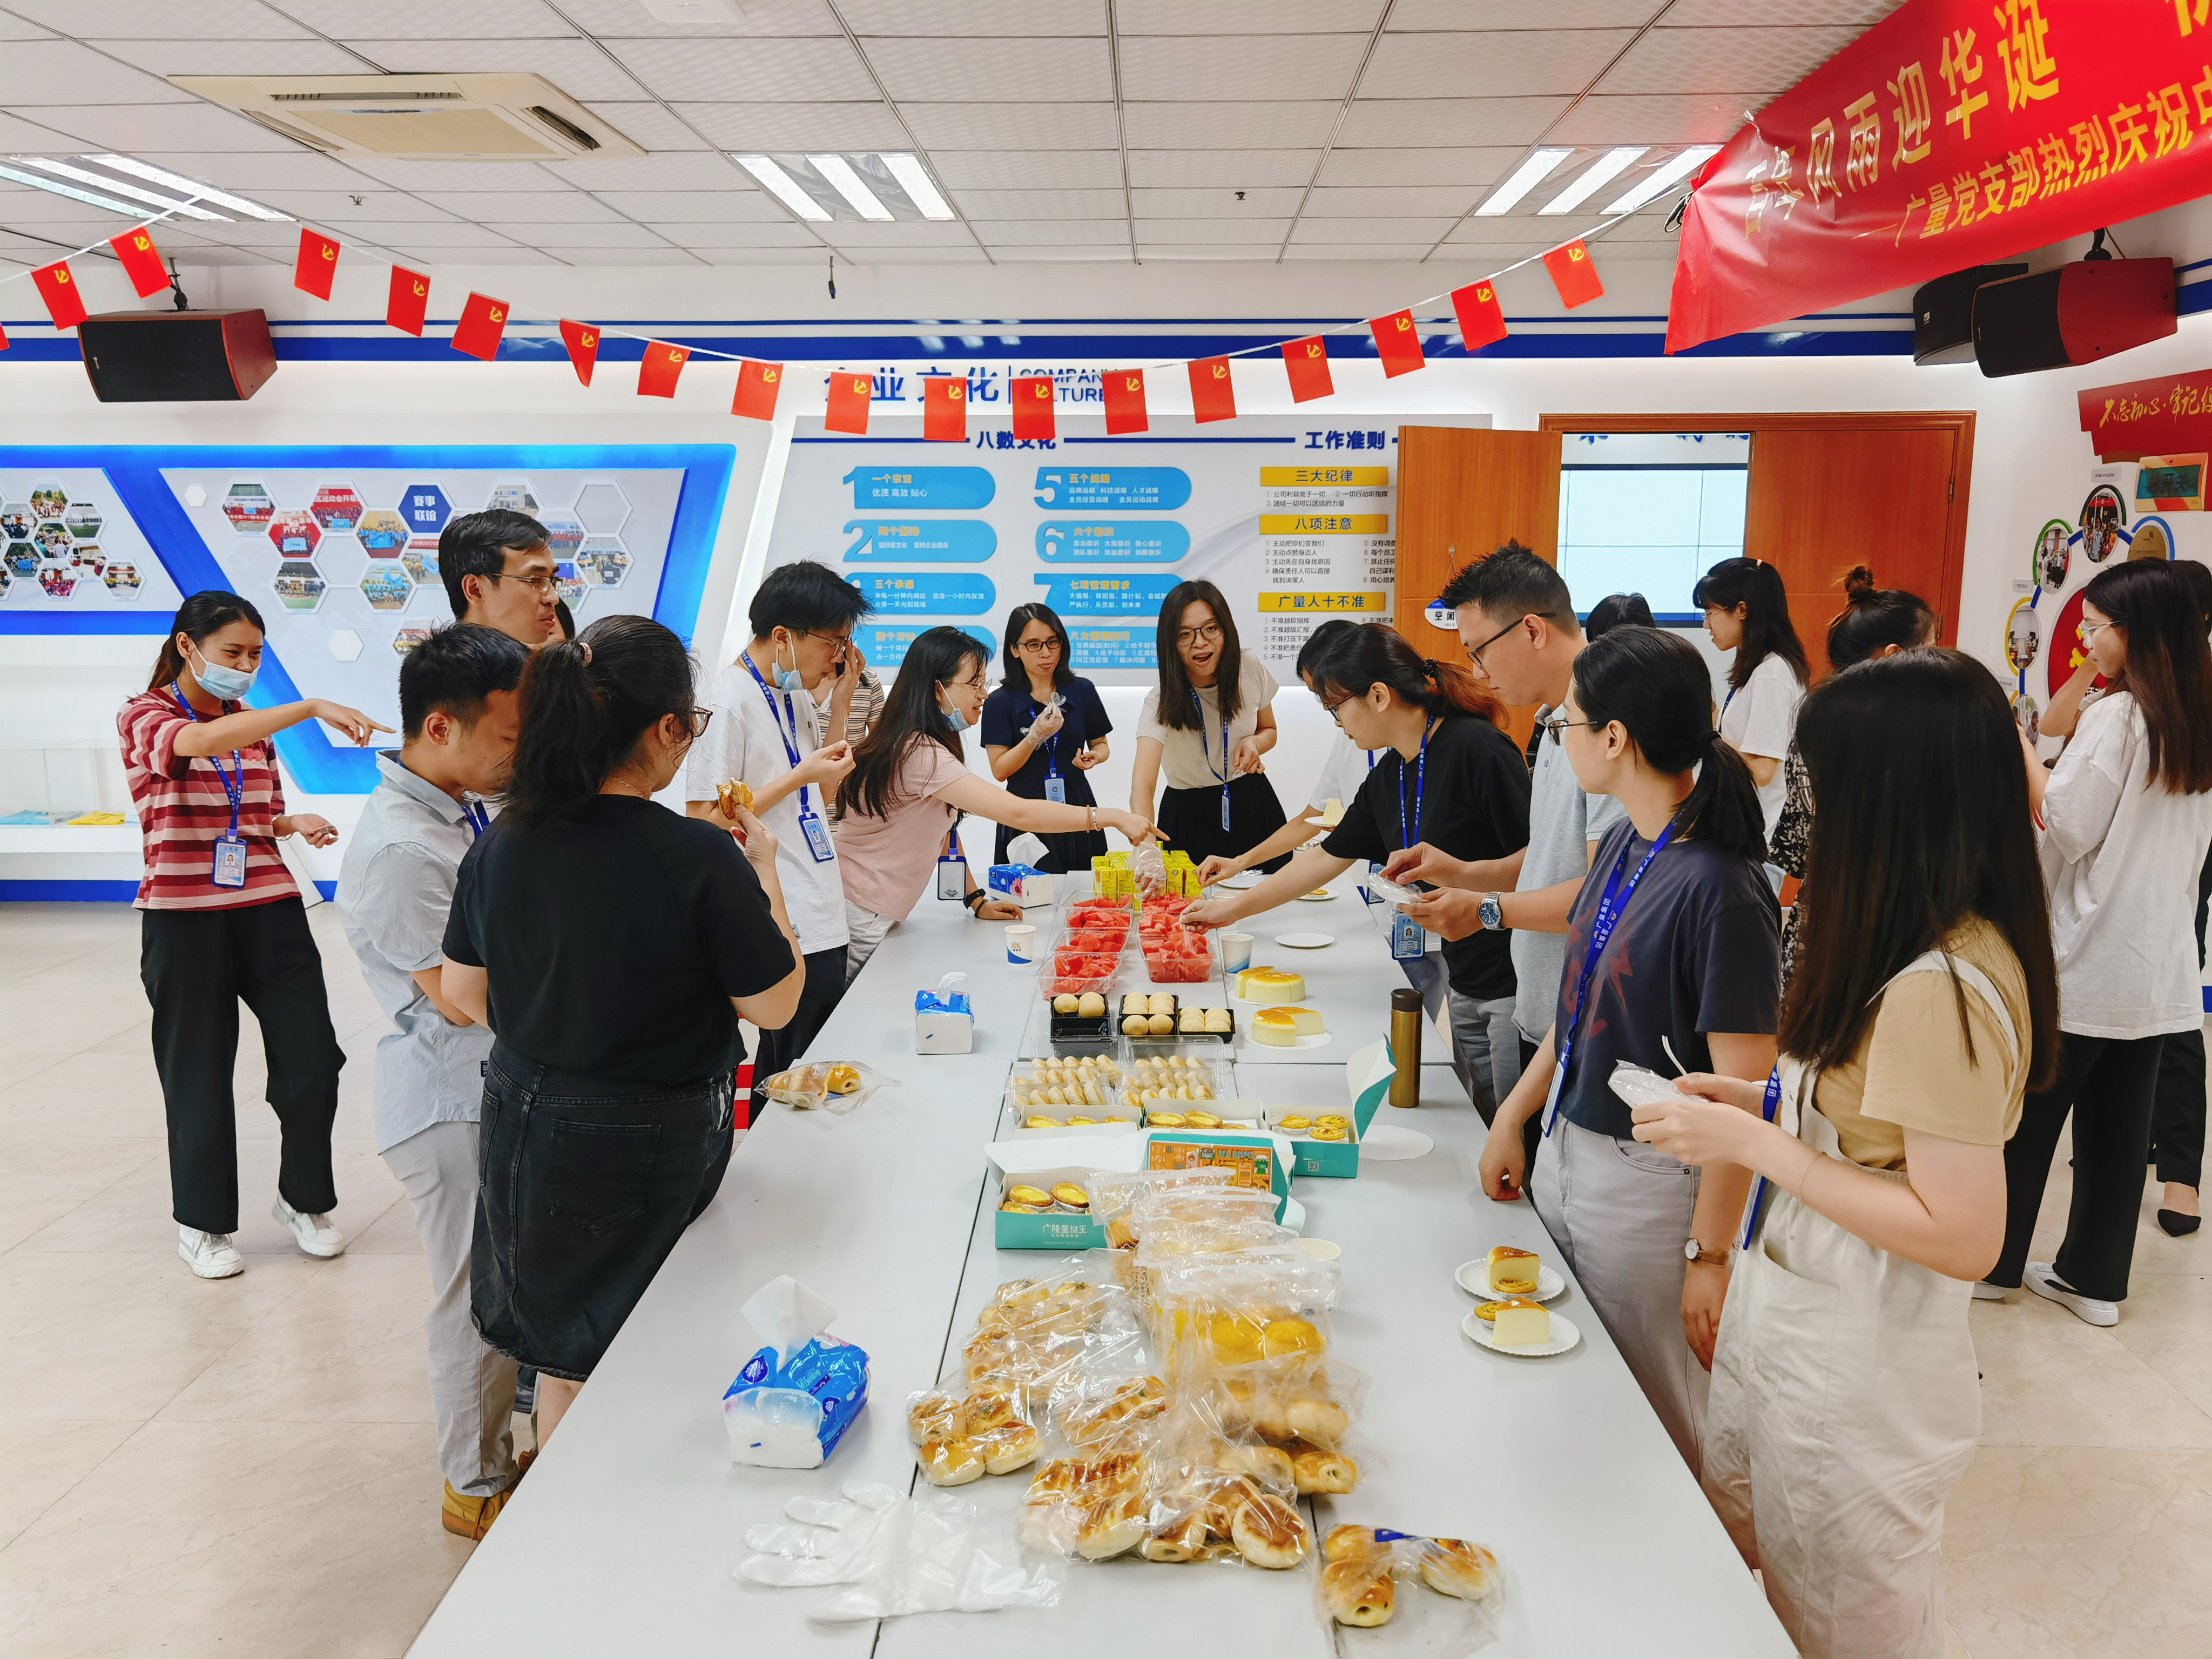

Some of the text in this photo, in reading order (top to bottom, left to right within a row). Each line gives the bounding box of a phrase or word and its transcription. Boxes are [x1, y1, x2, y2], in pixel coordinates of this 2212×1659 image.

[824, 366, 999, 403] 业化
[1304, 430, 1386, 450] 工作准则
[1068, 473, 1110, 484] 五个战略
[1295, 469, 1353, 483] 三大纪律
[1294, 517, 1352, 530] 八项注意
[1278, 595, 1365, 608] 广量人十不准
[1042, 1224, 1087, 1234] 广隆蛋挞王
